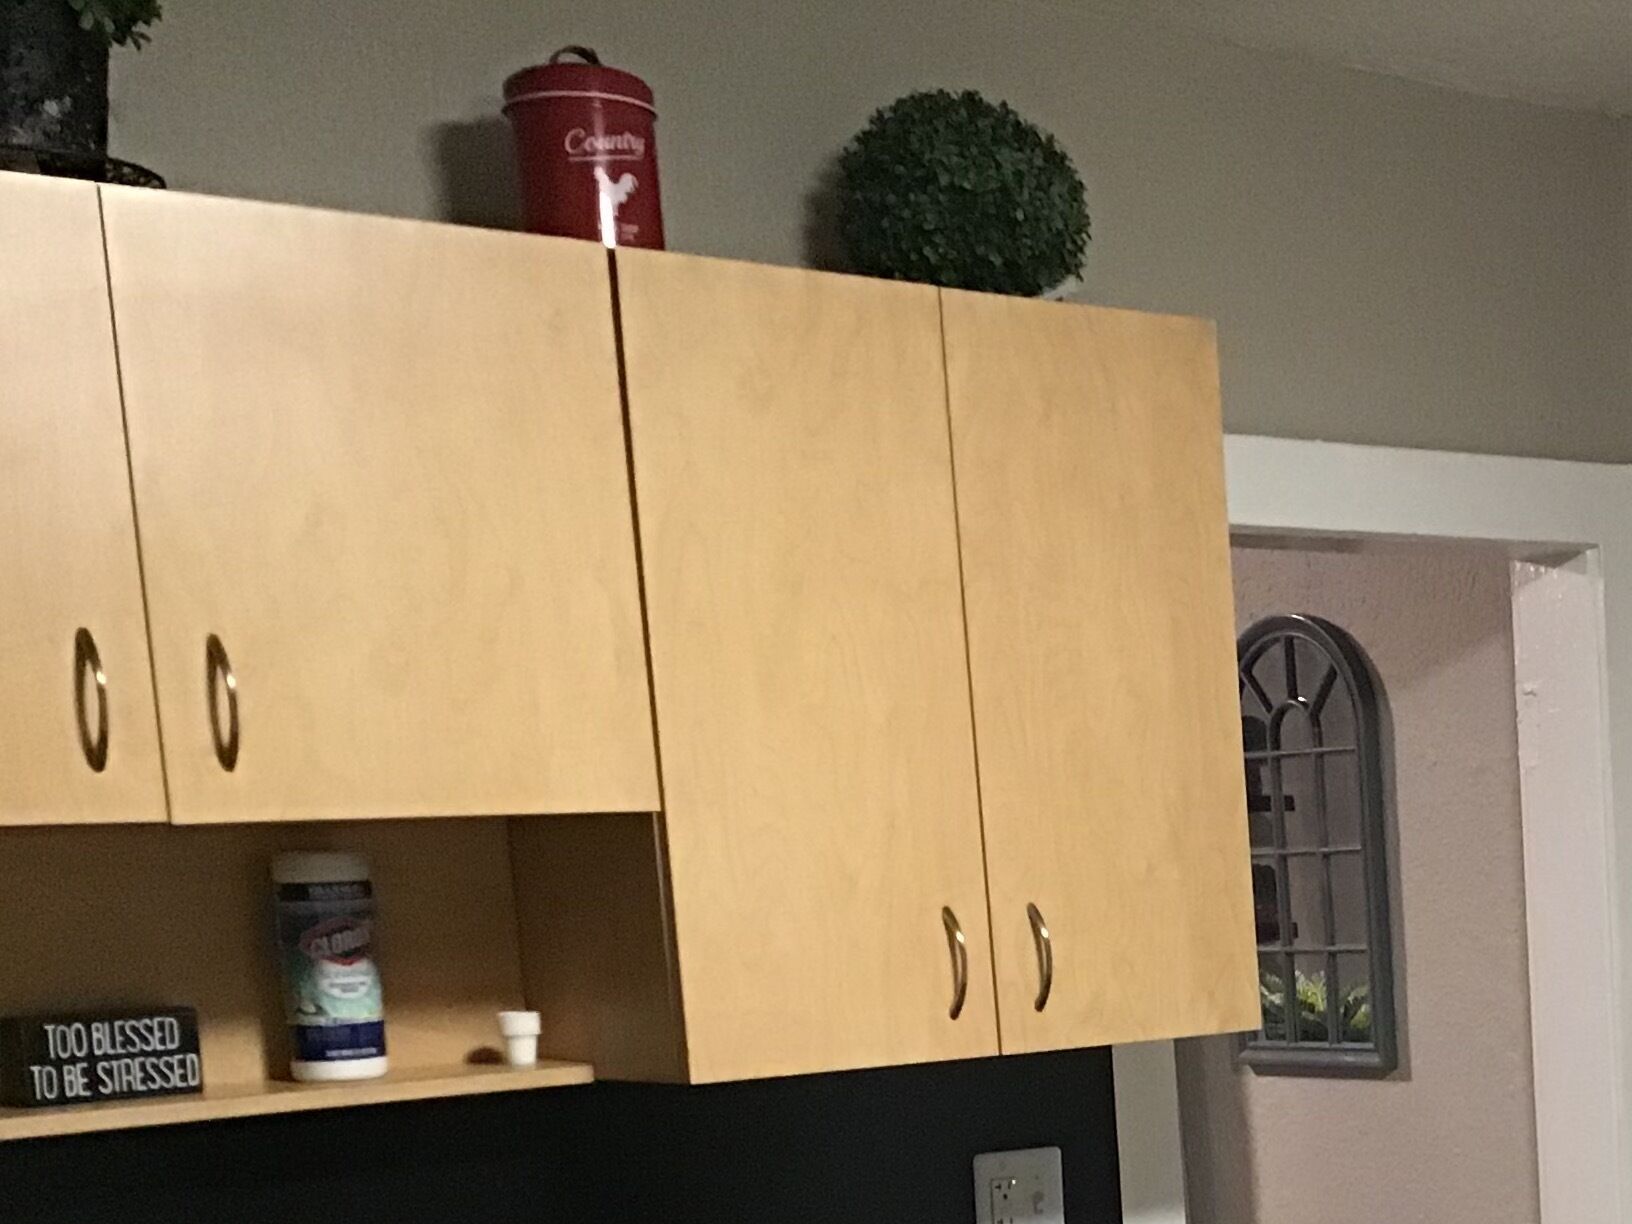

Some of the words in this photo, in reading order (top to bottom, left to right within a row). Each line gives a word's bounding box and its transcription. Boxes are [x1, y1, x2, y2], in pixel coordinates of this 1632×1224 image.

[44, 1023, 87, 1060] TOO
[91, 1017, 180, 1056] BLESSED
[29, 1065, 58, 1100] TO
[63, 1062, 92, 1098] BE
[97, 1053, 200, 1094] STRESSED
